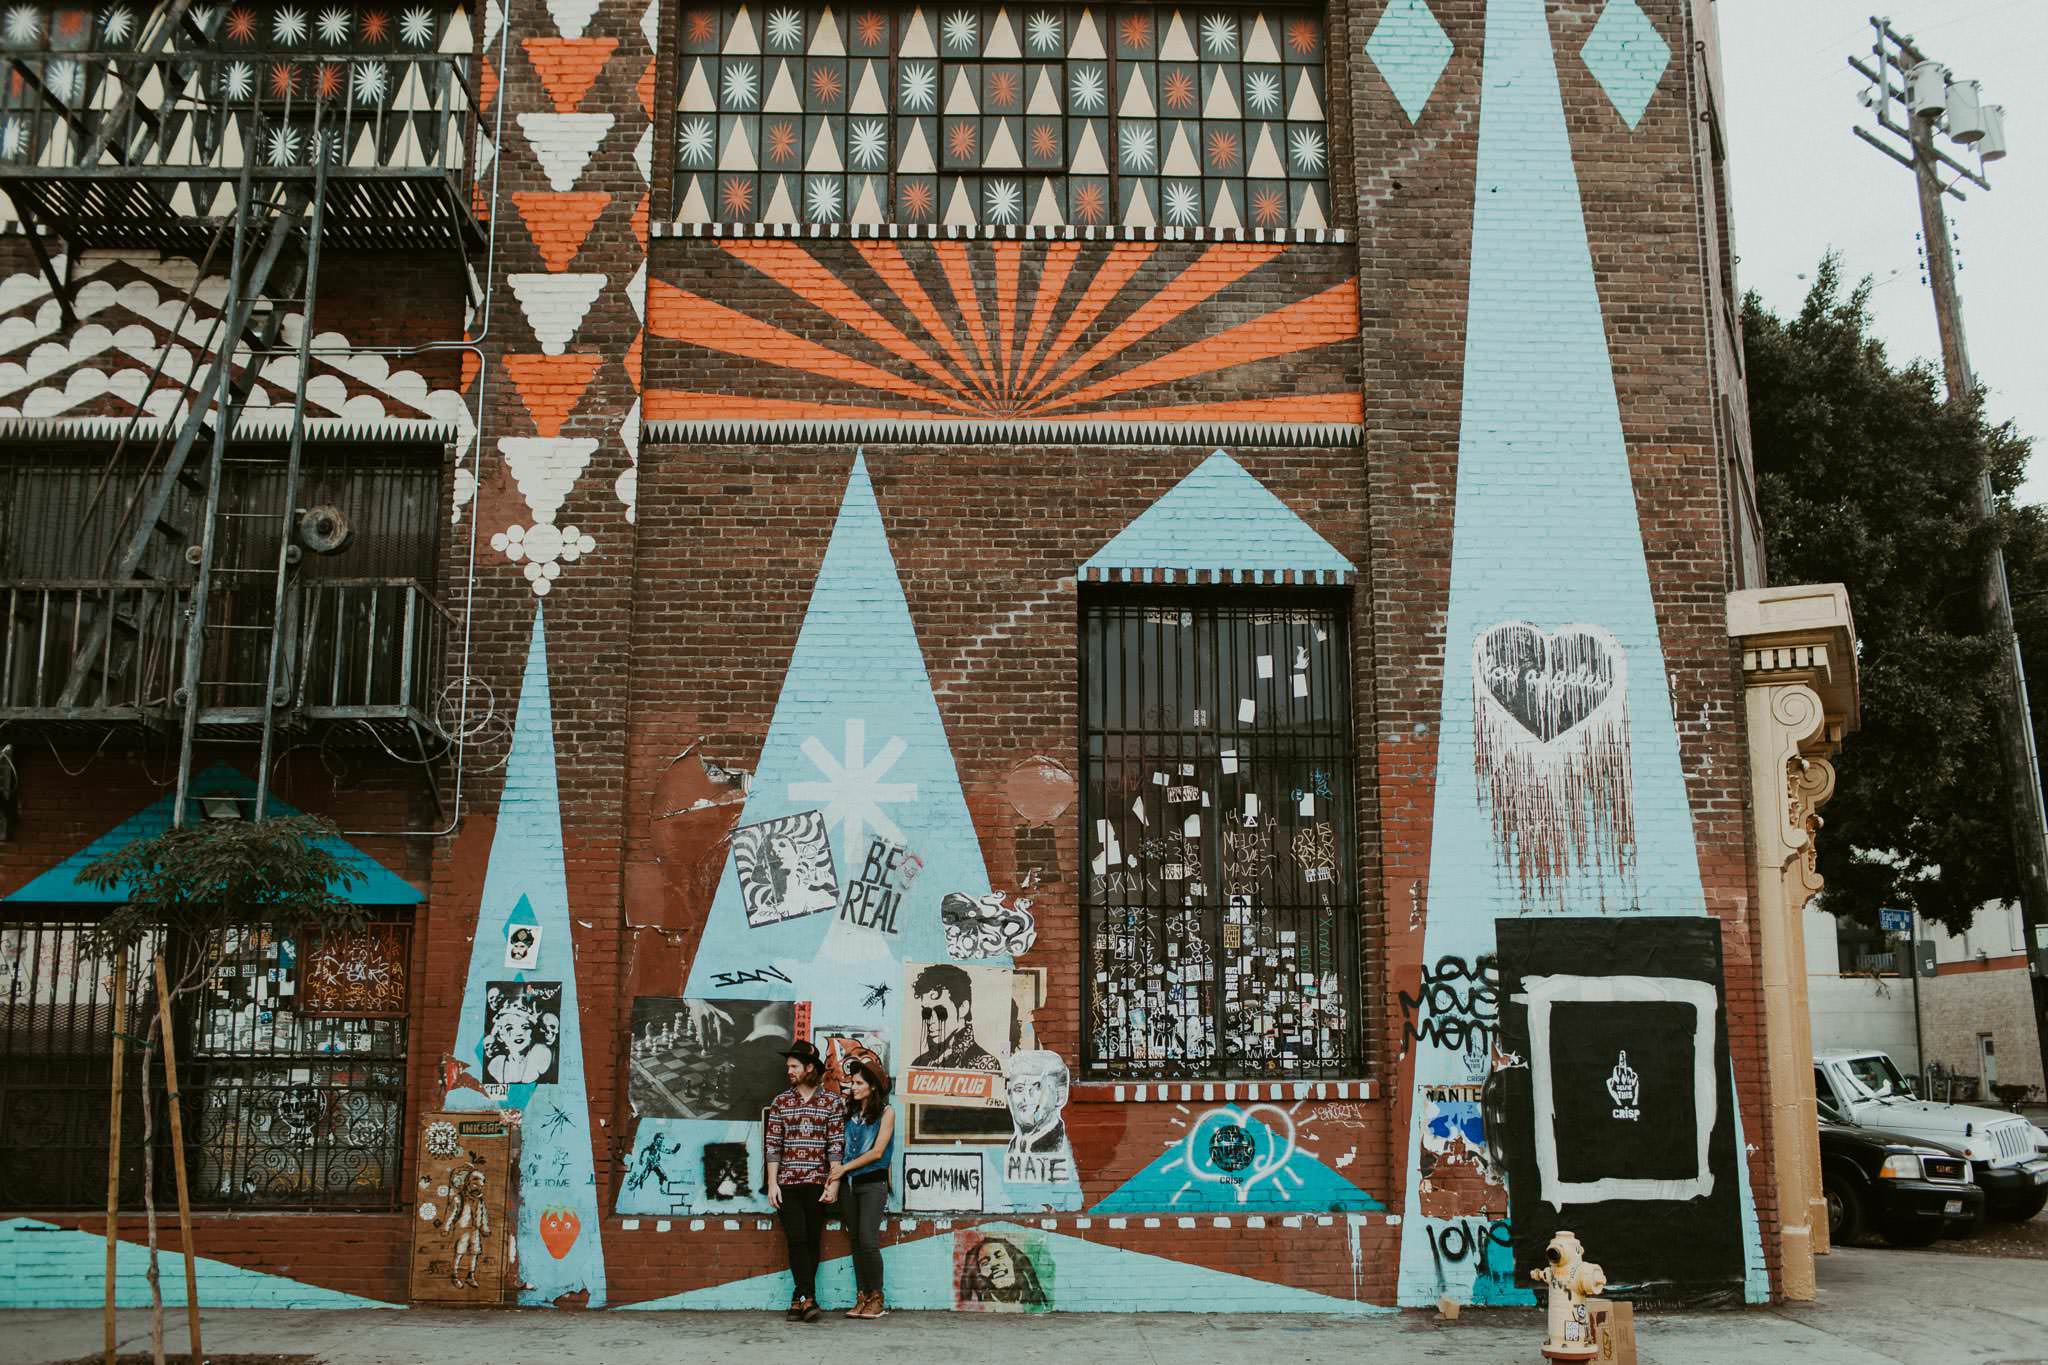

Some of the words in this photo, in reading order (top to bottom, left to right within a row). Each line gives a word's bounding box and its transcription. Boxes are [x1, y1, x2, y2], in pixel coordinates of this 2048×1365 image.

[861, 840, 904, 889] BE
[840, 879, 902, 934] REAL
[911, 1074, 952, 1093] VEGAN
[954, 1077, 987, 1095] CLUB
